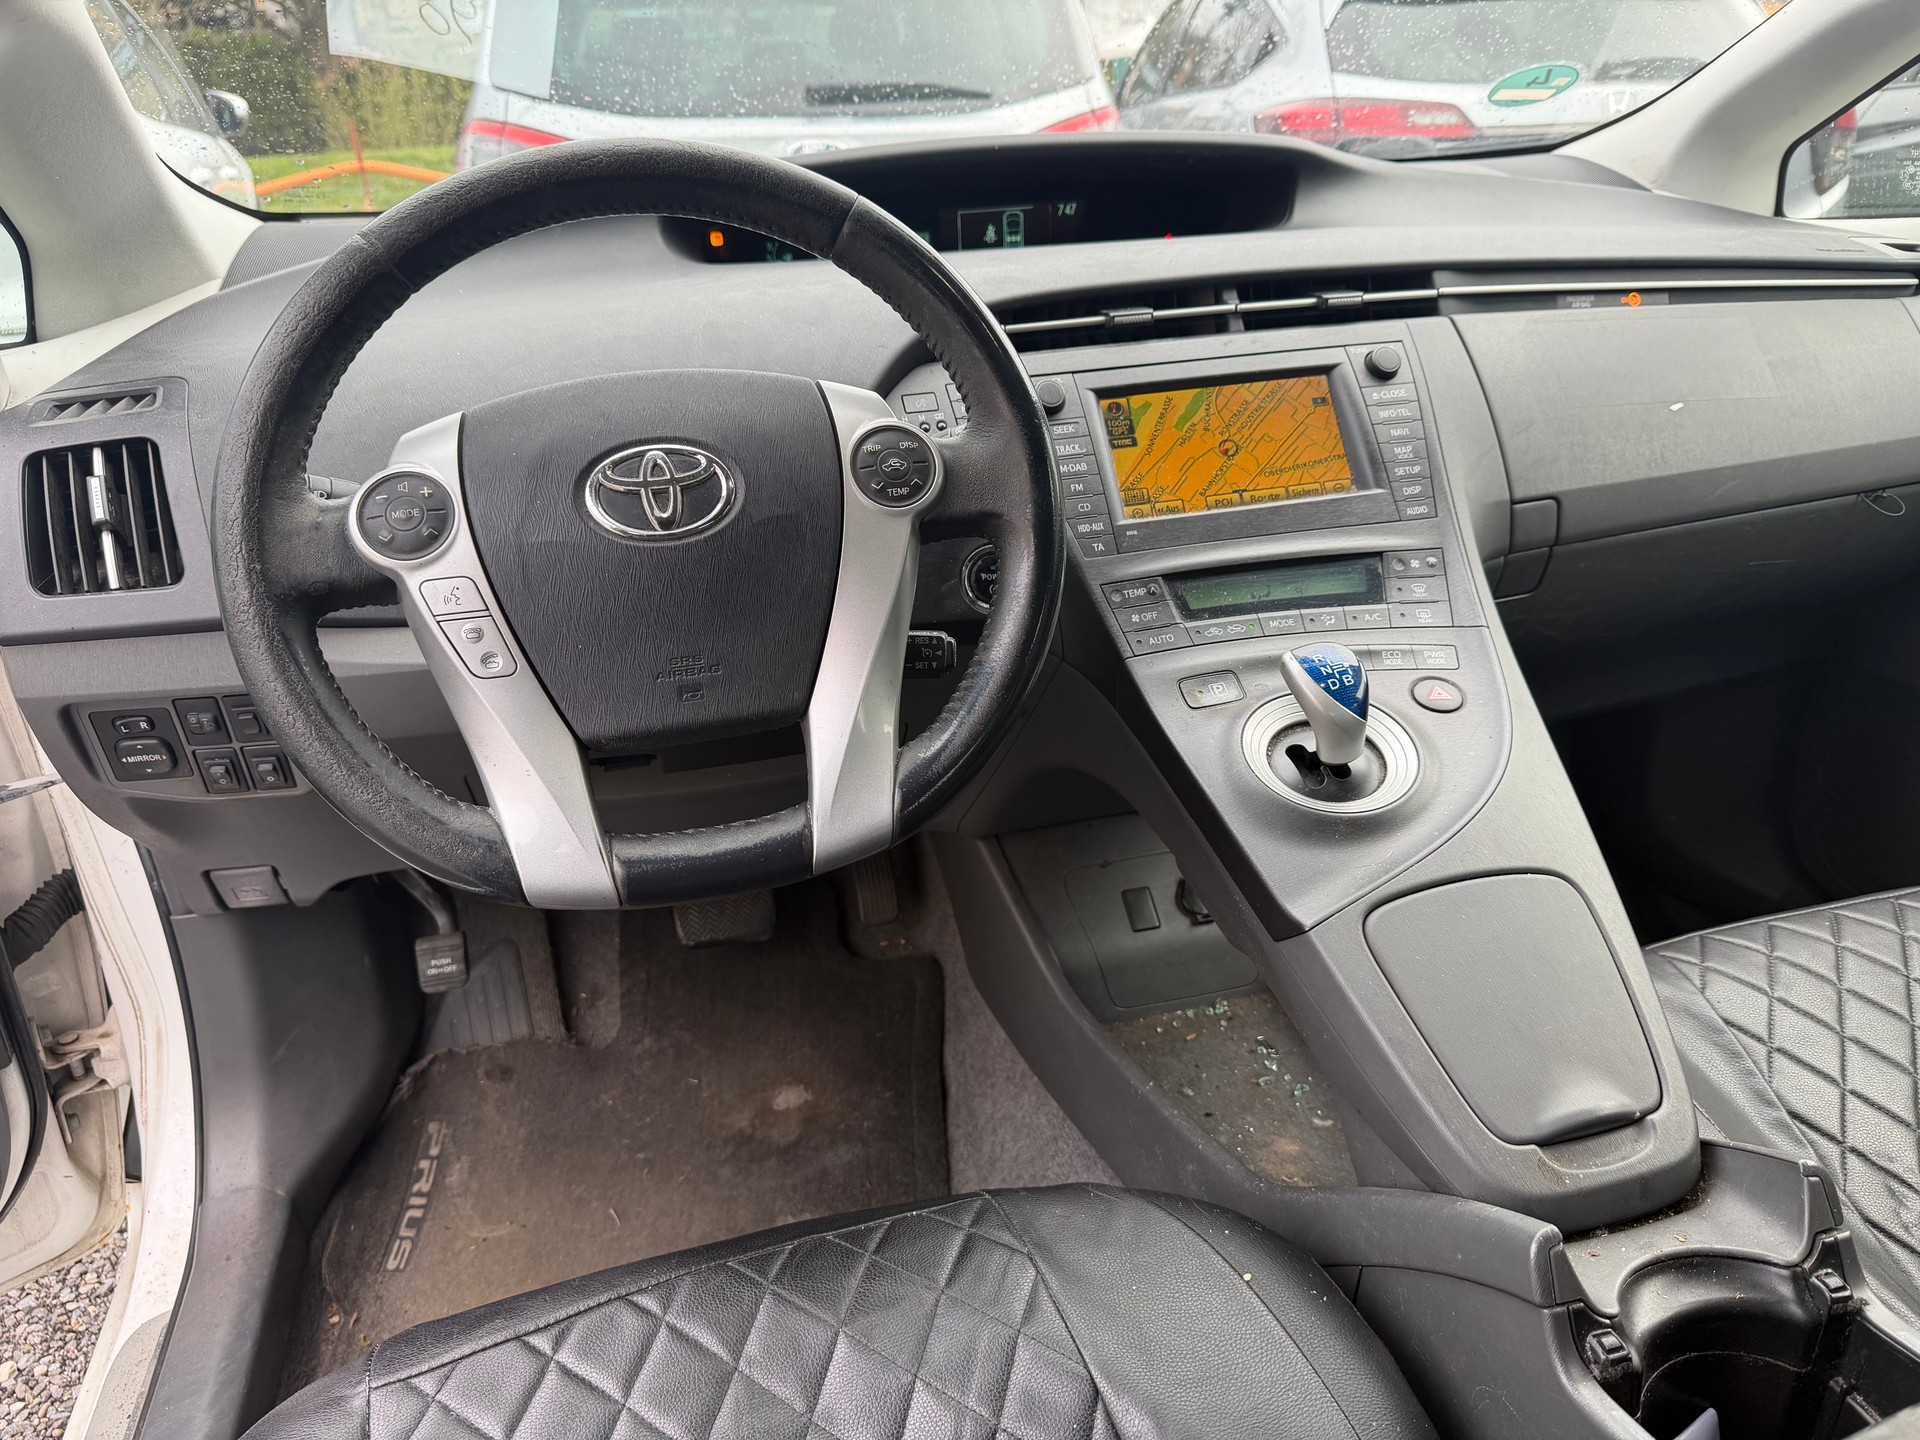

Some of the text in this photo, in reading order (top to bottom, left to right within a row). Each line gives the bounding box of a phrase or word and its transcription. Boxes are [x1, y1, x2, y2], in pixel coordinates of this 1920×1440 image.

[1237, 382, 1284, 434] INDUSTRIESTRASSE
[1219, 399, 1250, 437] RONSTRASSE
[1107, 420, 1130, 428] 100m
[1144, 396, 1173, 457] SONNENTERRASSE
[1053, 425, 1075, 434] SEEK
[1178, 422, 1197, 447] HALTEN
[1390, 428, 1409, 436] NAVI
[862, 441, 919, 453] TRIP DISP
[1055, 444, 1080, 453] TRACK
[1394, 446, 1412, 454] MAP
[1394, 465, 1420, 476] SETUP
[887, 487, 910, 496] TEMP
[1070, 483, 1084, 492] FM
[1402, 486, 1421, 495] DISP
[1251, 494, 1280, 503] Route
[1292, 488, 1319, 497] Sichern
[1077, 503, 1091, 512] CD
[1406, 505, 1428, 515] AUDIO
[391, 507, 420, 519] MODE
[1092, 543, 1105, 552] TA
[1123, 587, 1147, 598] TEMP
[1141, 611, 1158, 621] OFF
[1364, 613, 1382, 621] A/C
[1269, 618, 1296, 628] MODE
[915, 637, 930, 645] RES
[1149, 634, 1174, 645] AUTO
[1312, 654, 1326, 664] R
[1382, 651, 1401, 659] ECO
[1320, 666, 1333, 676] N
[1327, 675, 1354, 690] D B
[121, 721, 149, 733] L R
[127, 754, 162, 763] MIRROR
[430, 957, 452, 967] PUSH
[386, 1120, 449, 1271] PRIUS
